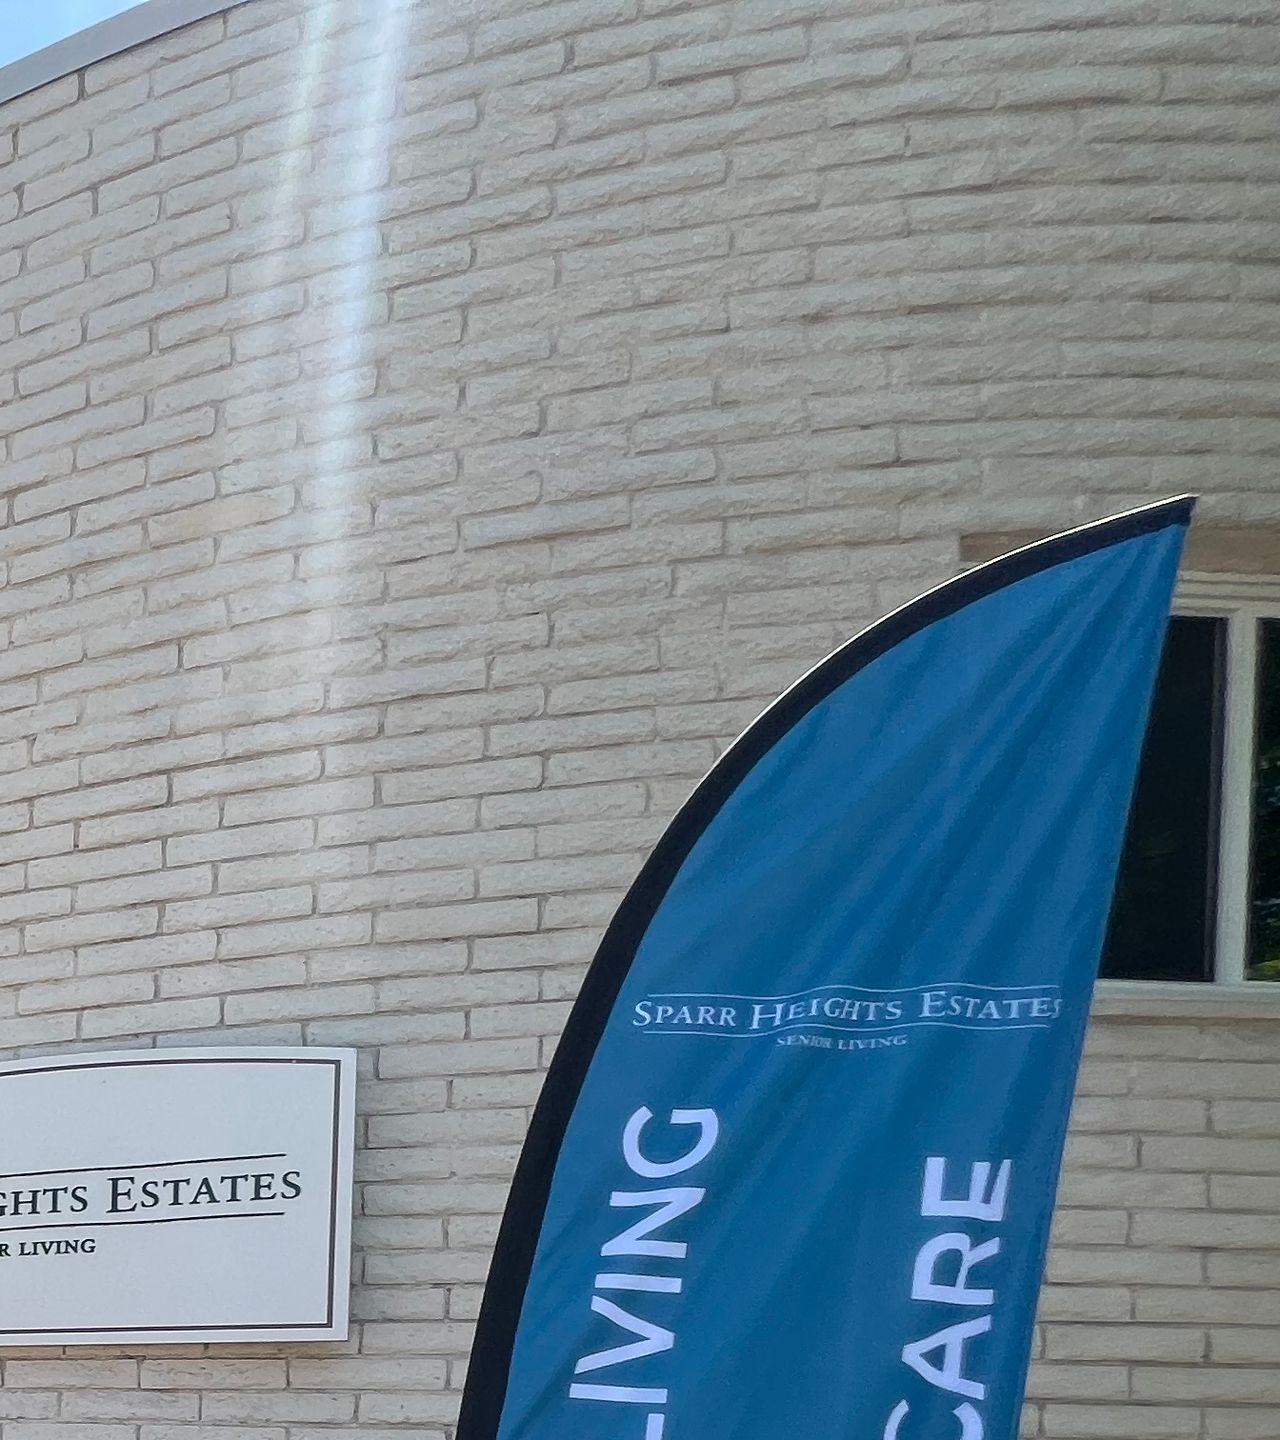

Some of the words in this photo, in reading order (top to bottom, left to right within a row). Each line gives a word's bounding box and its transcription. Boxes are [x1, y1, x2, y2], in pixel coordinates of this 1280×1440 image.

[633, 1000, 737, 1027] SPARR
[750, 997, 903, 1030] HEIGHTS
[918, 990, 1063, 1020] ESTATES
[776, 1034, 832, 1049] SENIOR
[837, 1034, 908, 1051] LIVING
[105, 1170, 304, 1215] ESTATES
[18, 1237, 97, 1258] LIVING
